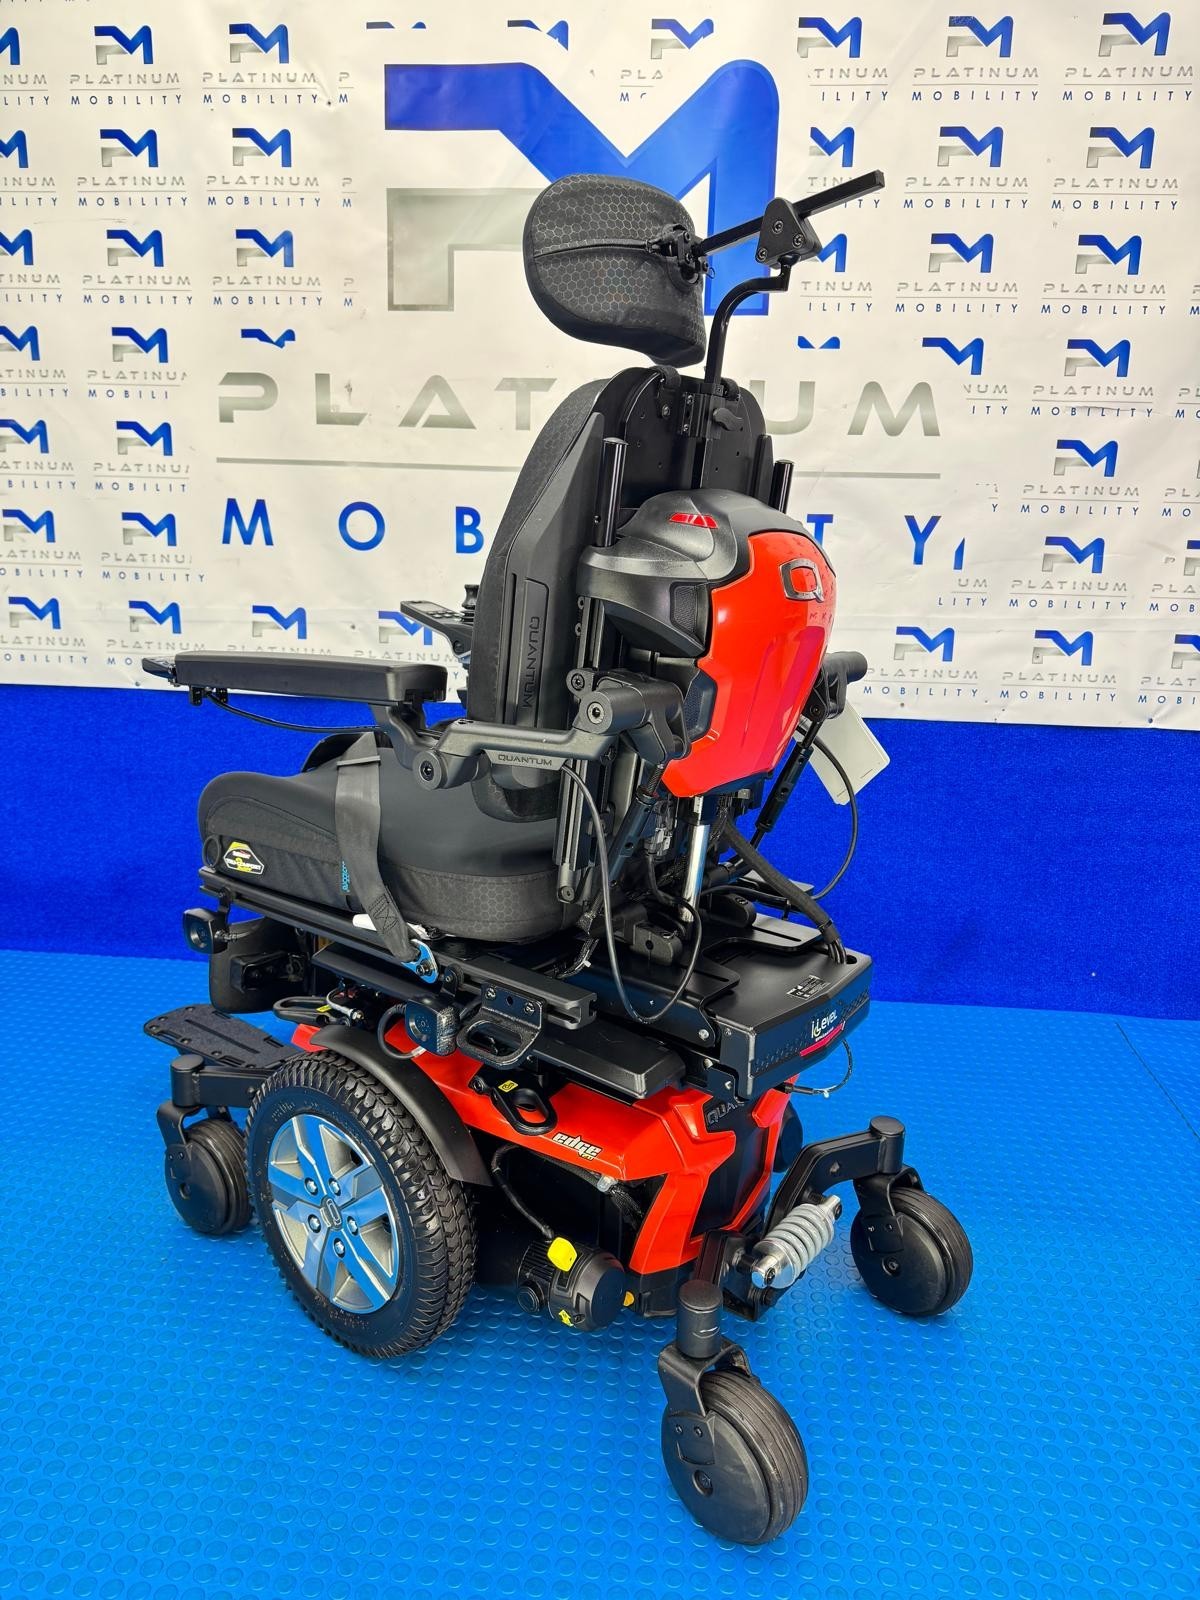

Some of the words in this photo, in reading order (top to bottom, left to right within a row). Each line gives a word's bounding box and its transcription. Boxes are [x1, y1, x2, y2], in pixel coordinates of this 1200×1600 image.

[808, 68, 888, 78] TINUM
[914, 67, 1038, 78] PLATINUM
[1065, 66, 1193, 77] PLATINUM
[70, 73, 179, 84] PLATINUM
[203, 72, 316, 83] PLATINUM
[71, 95, 181, 105] MOBILITY
[203, 94, 317, 104] MOBILITY
[912, 91, 1038, 101] MOBILITY
[1063, 91, 1192, 101] MOBILITY
[77, 176, 184, 186] PLATINUM
[207, 176, 319, 186] PLATINUM
[906, 177, 1028, 187] PLATINUM
[1054, 178, 1178, 188] PLATINUM
[79, 197, 187, 206] MOBILITY
[208, 196, 320, 207] MOBILITY
[904, 198, 1028, 208] MOBILITY
[1052, 200, 1177, 210] MOBILITY
[83, 275, 190, 285] PLATINUM
[213, 276, 320, 285] PLATINUM
[897, 282, 1017, 292] PLATINUM
[1044, 284, 1165, 294] PLATINUM
[84, 295, 192, 304] MOBILITY
[214, 296, 322, 306] MOBILITY
[895, 303, 1017, 313] MOBILITY
[1041, 305, 1165, 314] MOBILITY
[1033, 385, 1153, 396] PLATINUM
[219, 371, 940, 437] PLATUM
[1031, 406, 1152, 418] MOBILITY
[94, 463, 189, 473] PLATINU
[1024, 485, 1139, 496] PLATINUM
[1021, 505, 1138, 515] MOBILITY
[222, 497, 941, 566] MOBTY
[102, 552, 192, 564] PLATINU
[103, 572, 204, 582] MOBILITY
[1011, 580, 1126, 591] PLATINUM
[1009, 599, 1126, 610] MOBILITY
[107, 639, 205, 651] PLATINUM
[522, 616, 540, 708] QUANTUM
[867, 667, 977, 680] PLATINUM
[1003, 672, 1116, 683] PLATINUM
[864, 686, 977, 696] MOBILITY
[1000, 690, 1116, 702] MOBILITY
[498, 754, 552, 766] QUANTUM
[552, 1132, 602, 1158] edge
